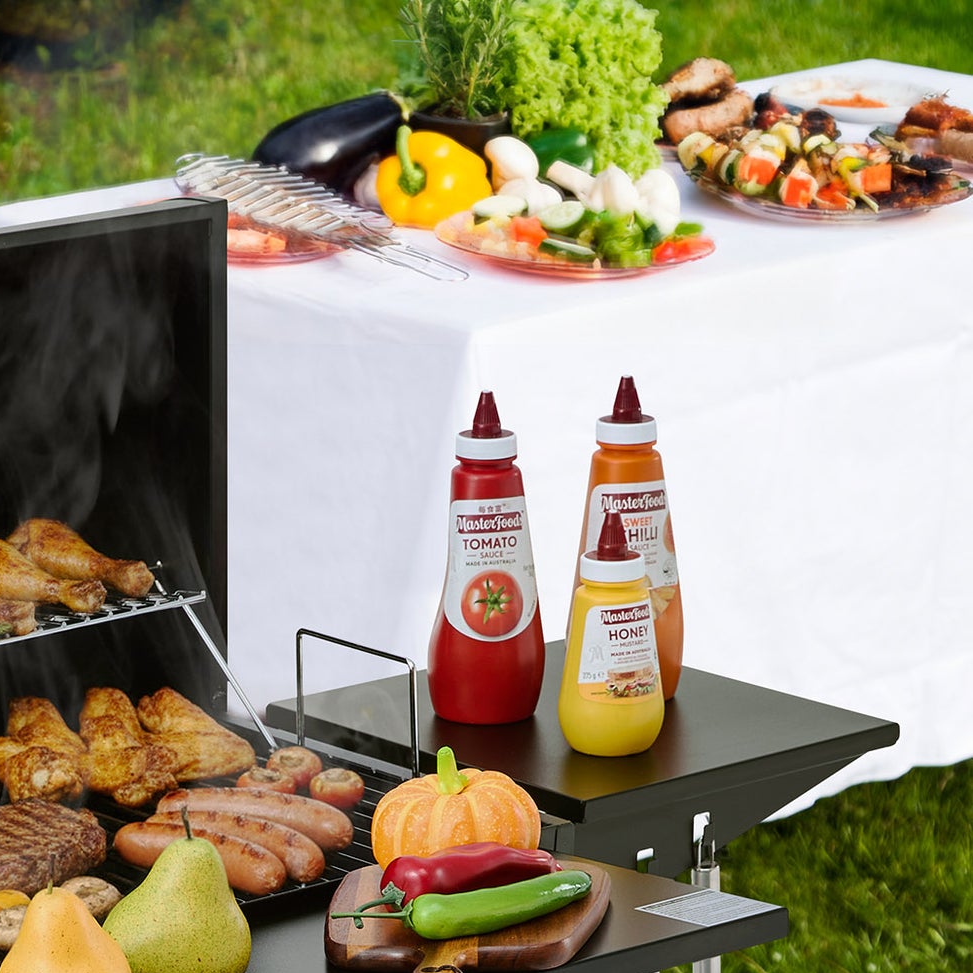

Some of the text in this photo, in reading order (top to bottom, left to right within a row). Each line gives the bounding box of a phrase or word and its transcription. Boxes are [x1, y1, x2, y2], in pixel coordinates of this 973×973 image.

[624, 516, 653, 528] SWEET
[625, 526, 658, 542] HILLI
[463, 536, 517, 550] TOMATO
[480, 551, 503, 559] SAUCE
[609, 625, 648, 640] HONEY
[619, 639, 644, 648] MUSTARD
